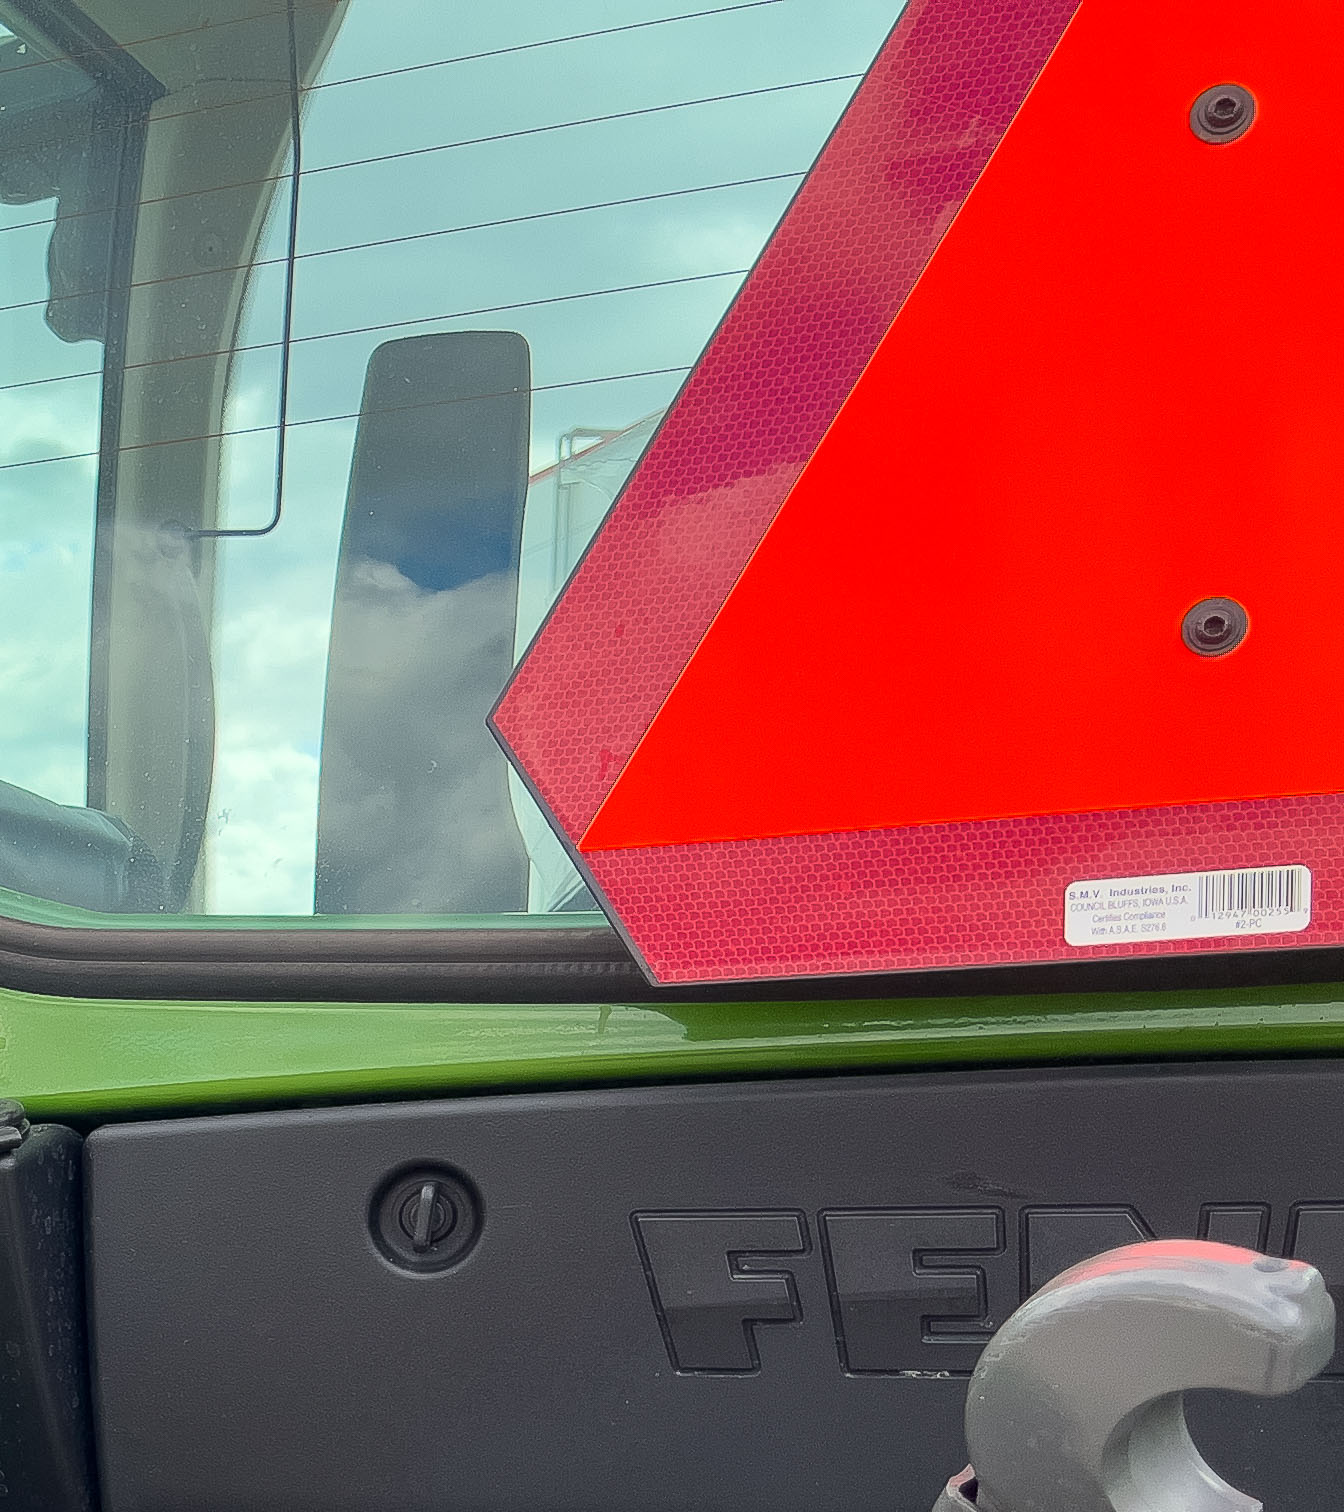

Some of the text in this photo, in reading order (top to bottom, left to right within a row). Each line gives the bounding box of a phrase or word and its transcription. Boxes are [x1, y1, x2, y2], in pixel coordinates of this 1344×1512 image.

[1110, 884, 1168, 897] Industries,
[1171, 884, 1192, 892] Inc.
[1070, 901, 1106, 912] COUNCIL
[1142, 898, 1164, 906] IOWA
[1124, 911, 1166, 922] Compliance
[1212, 907, 1290, 920] 12947 00255
